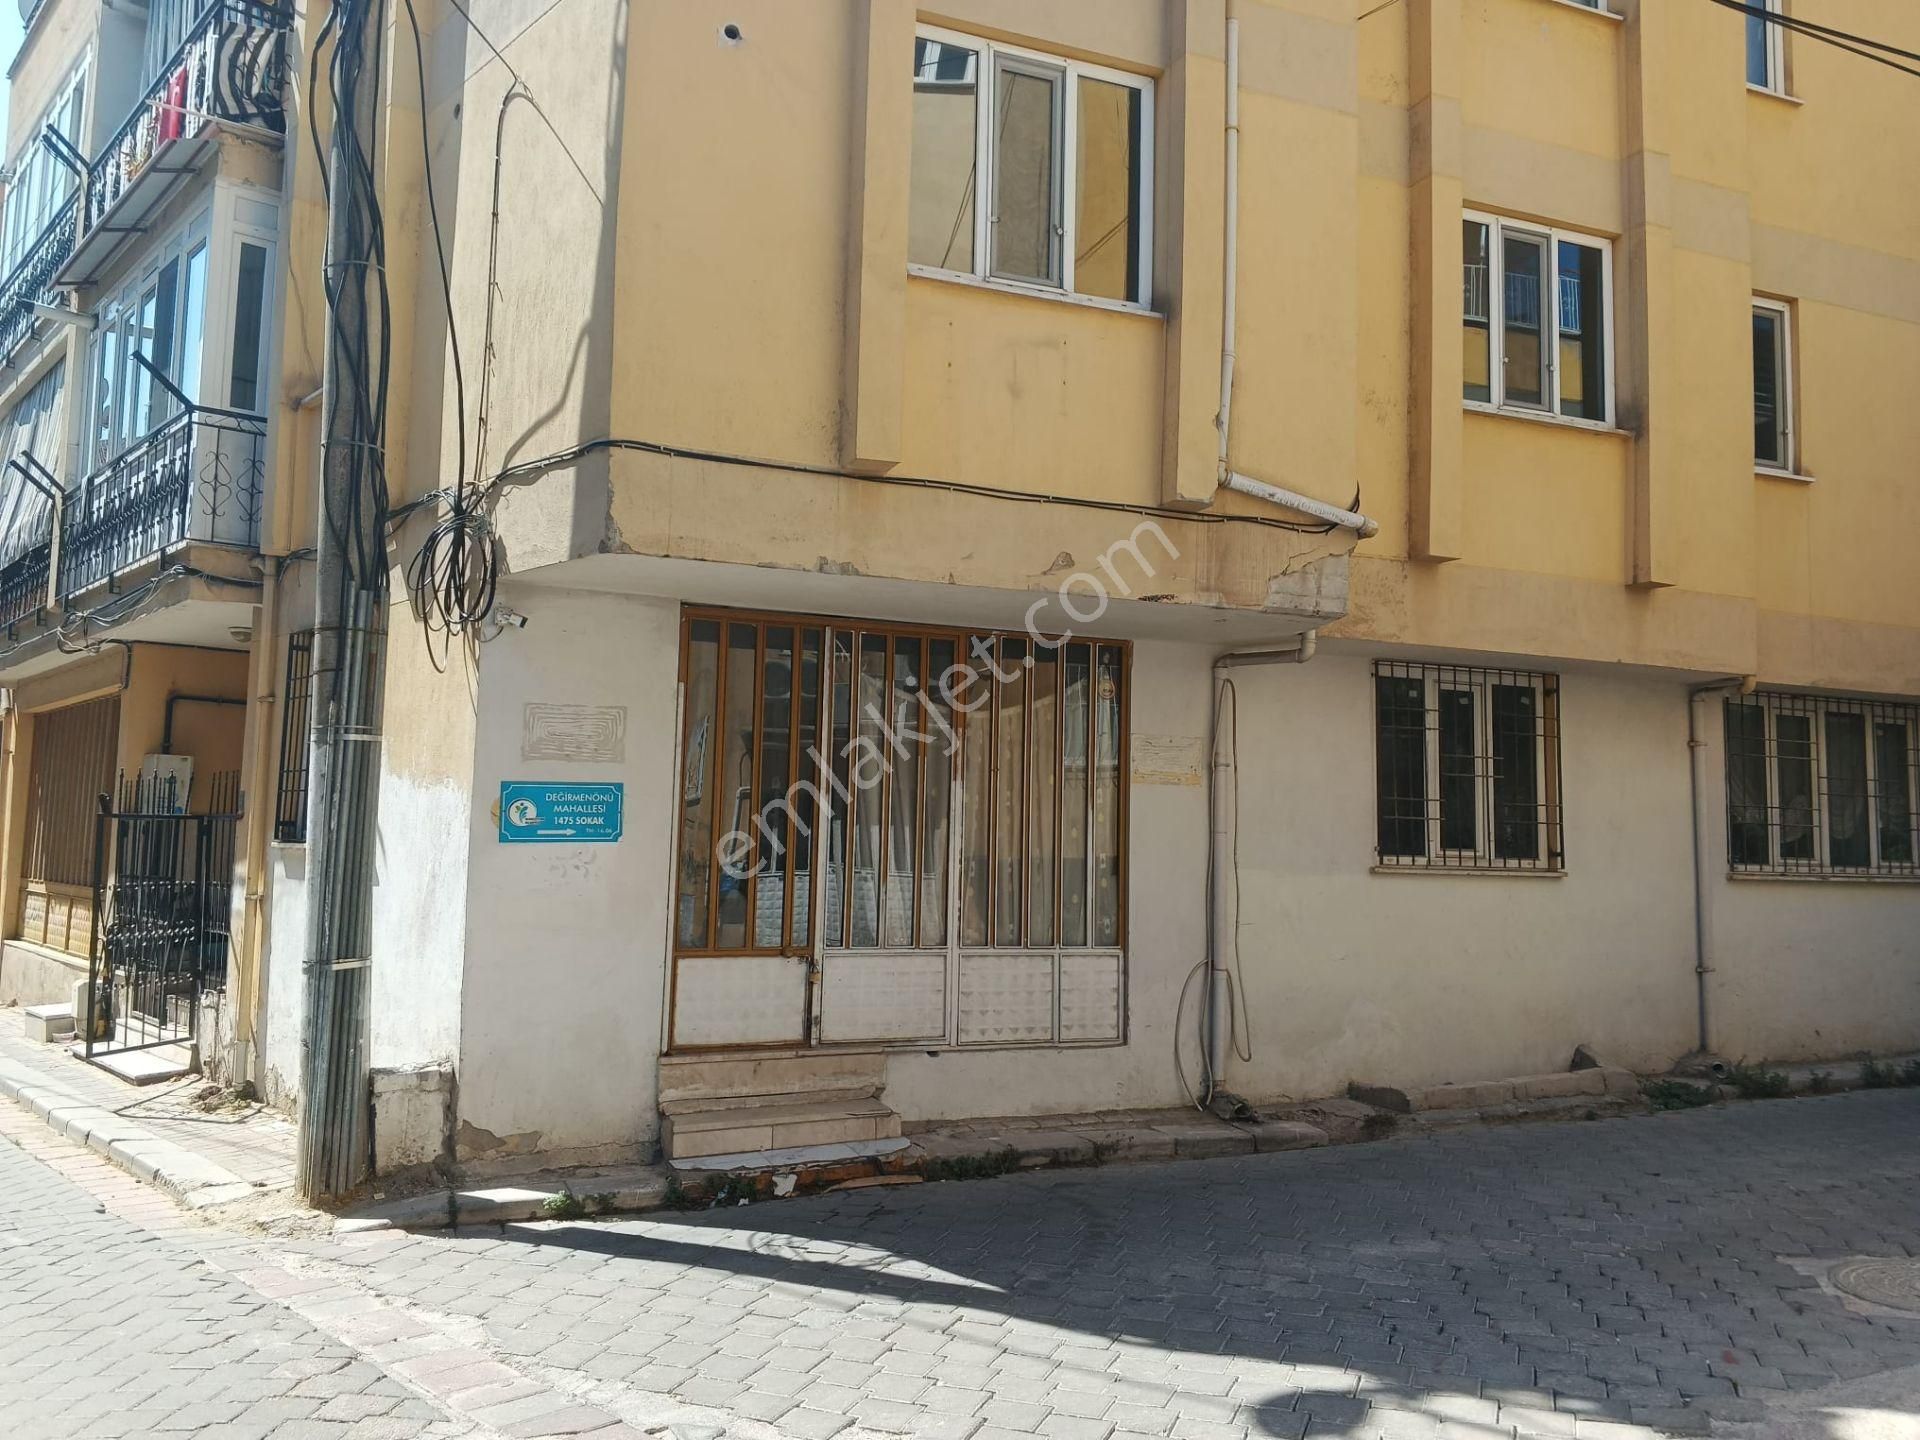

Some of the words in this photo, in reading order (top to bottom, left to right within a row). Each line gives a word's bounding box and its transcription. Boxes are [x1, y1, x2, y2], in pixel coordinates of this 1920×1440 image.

[545, 791, 614, 802] DEĞİRMENÖNÜ
[553, 803, 606, 813] MAHALLESİ
[554, 816, 574, 825] 1475
[575, 816, 604, 825] SOKAK
